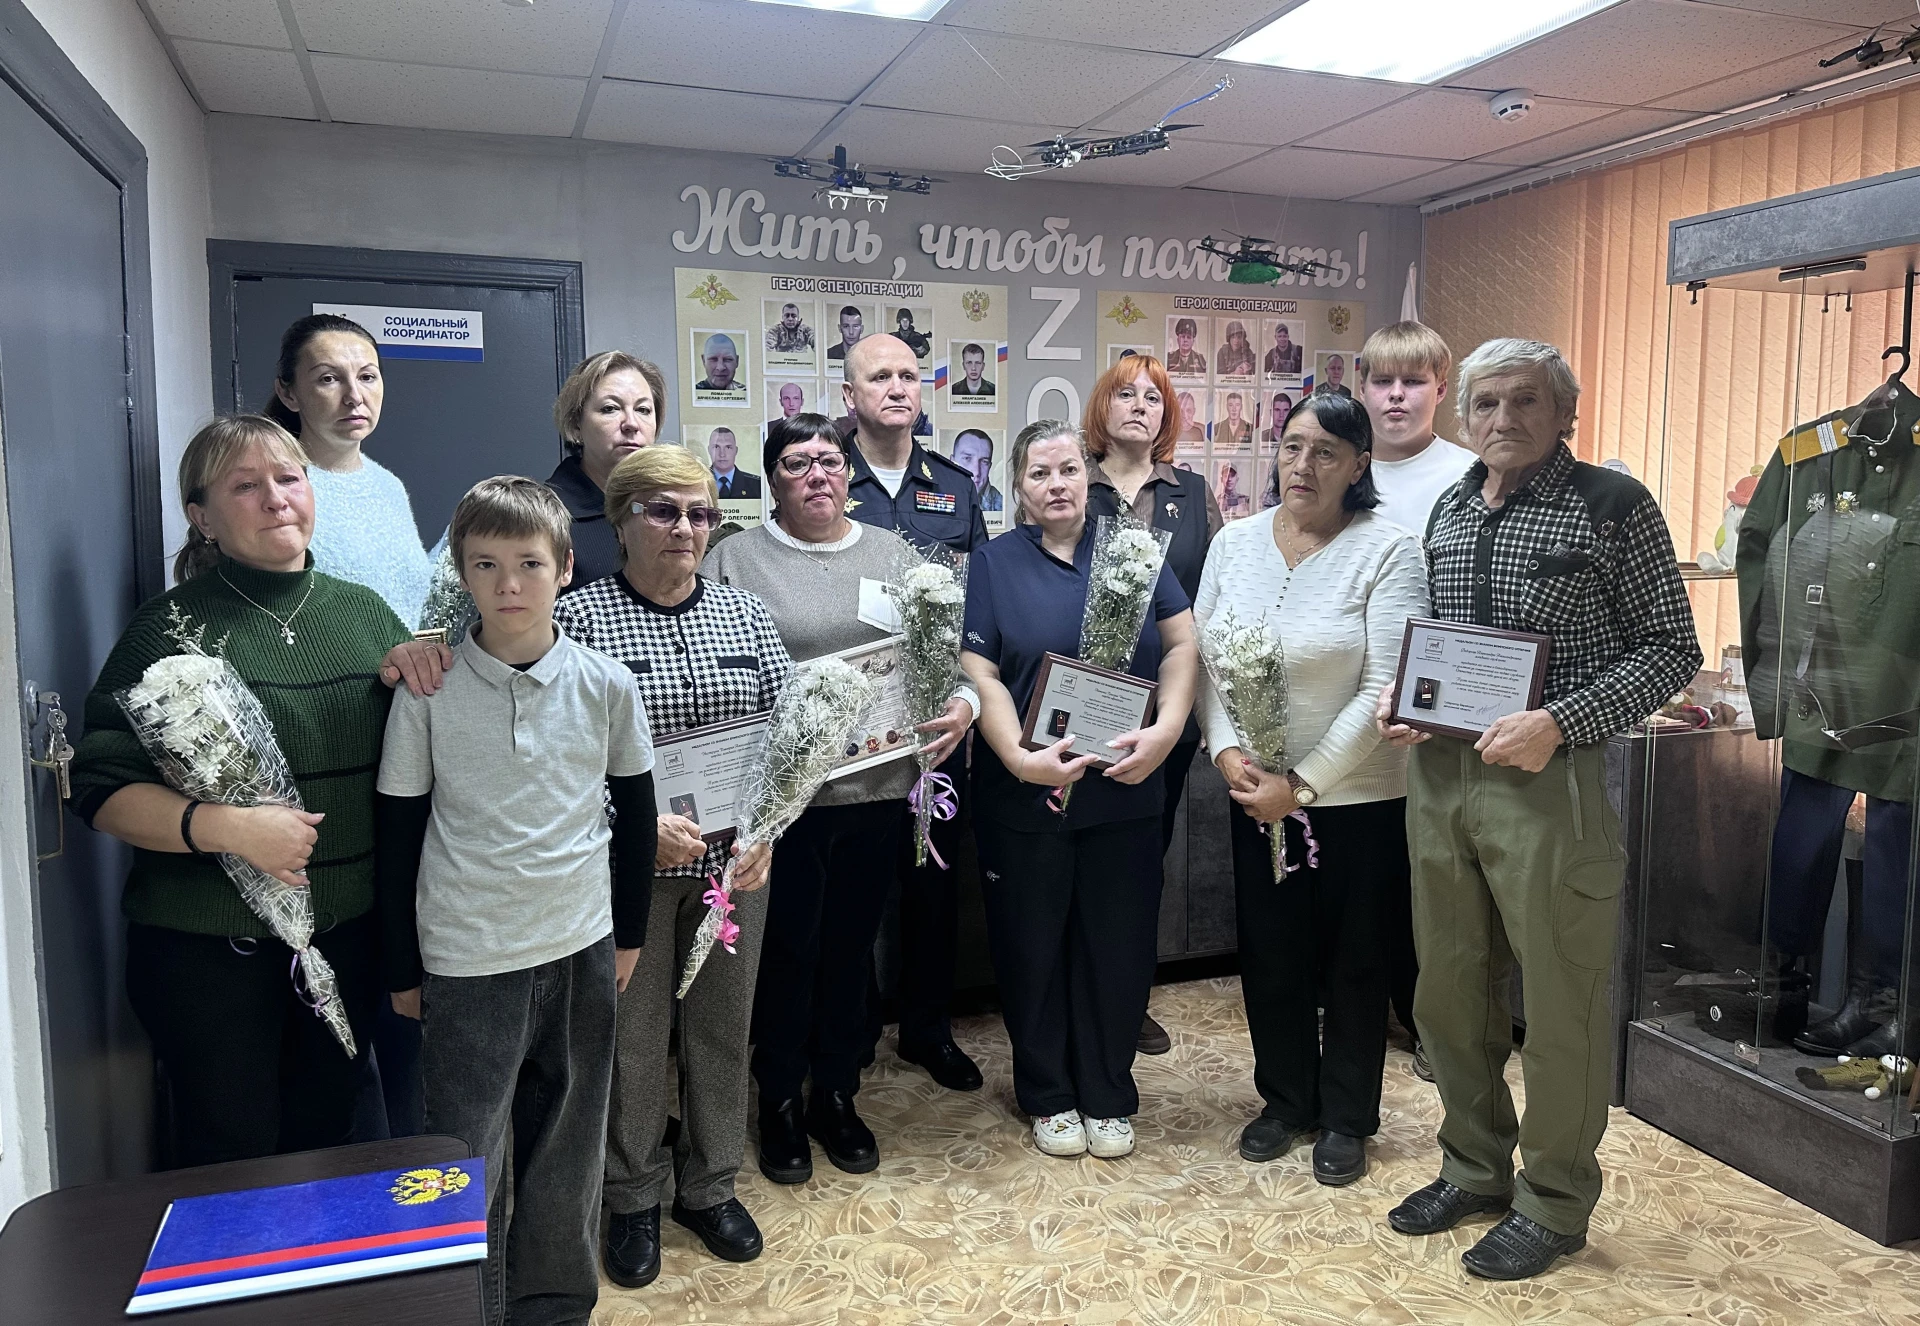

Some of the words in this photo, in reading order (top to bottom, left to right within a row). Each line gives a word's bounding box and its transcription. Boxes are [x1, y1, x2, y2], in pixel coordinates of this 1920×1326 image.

[919, 217, 1106, 276] чтобы
[1121, 231, 1368, 290] помить!
[772, 277, 815, 292] ГЕРОИ
[816, 280, 923, 298] СПЕЦОПЕРАЦИИ
[1174, 297, 1209, 310] ГЕРОИ
[1212, 298, 1297, 313] СПЕЦОПЕРАЦИИ
[384, 316, 468, 328] СОЦИАЛЬНЫЙ
[383, 328, 470, 340] КООРДИНАТОР
